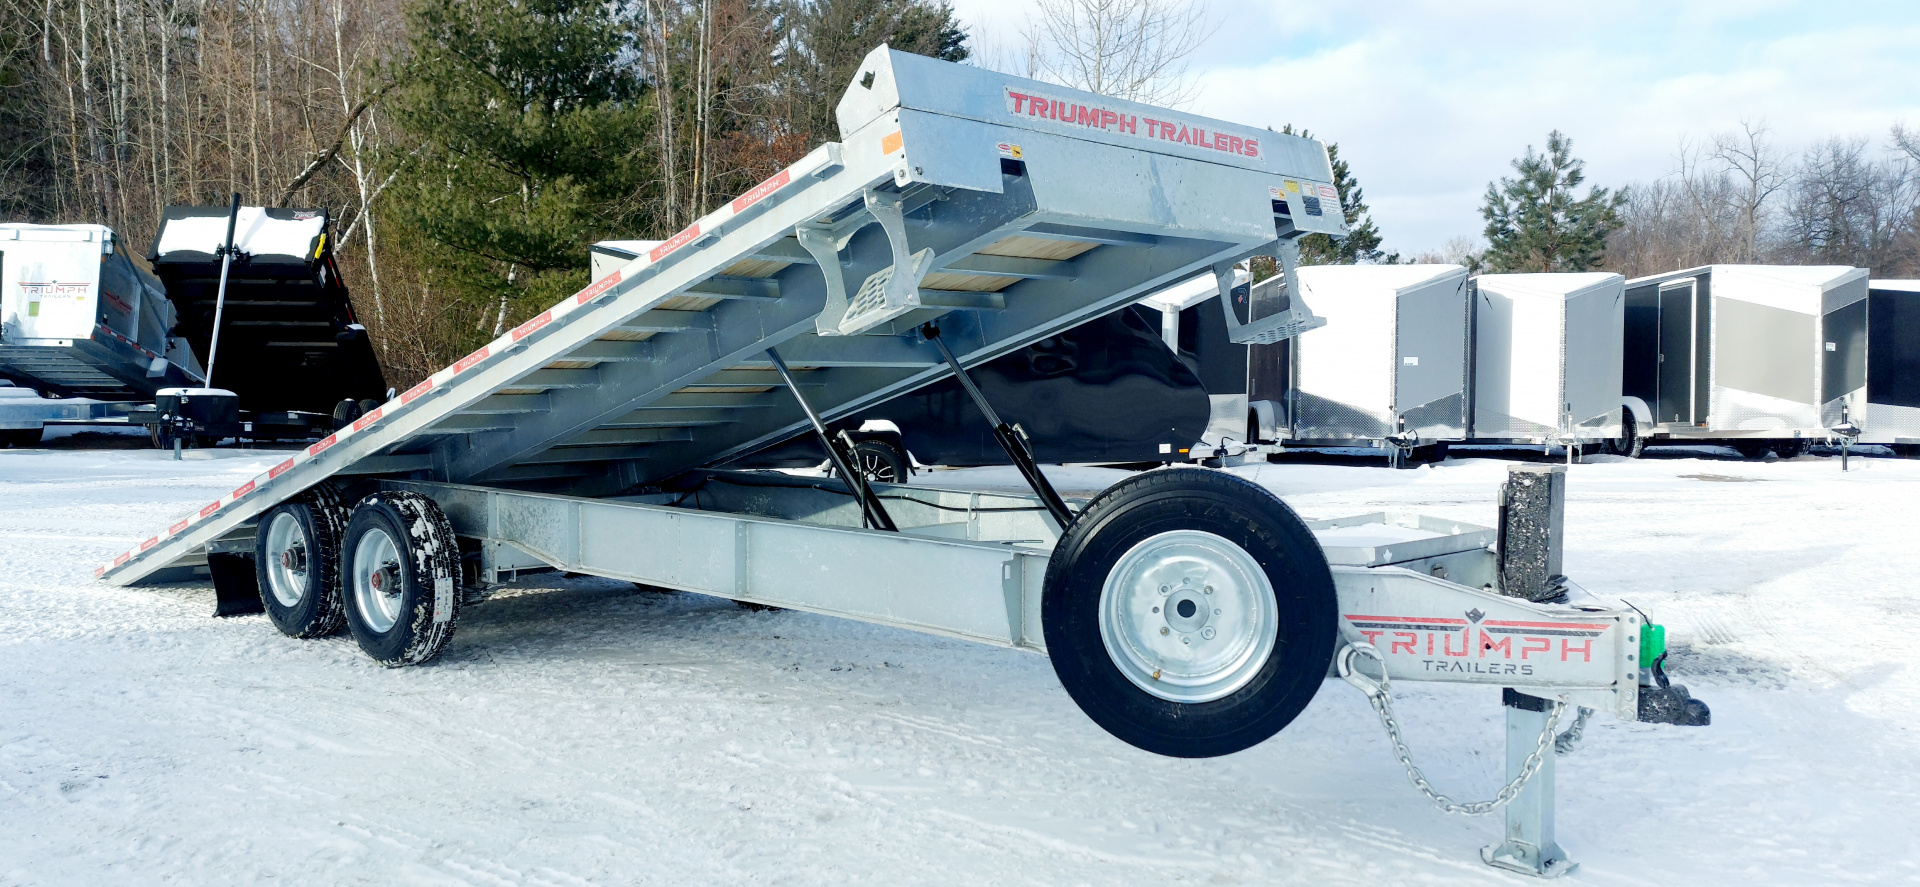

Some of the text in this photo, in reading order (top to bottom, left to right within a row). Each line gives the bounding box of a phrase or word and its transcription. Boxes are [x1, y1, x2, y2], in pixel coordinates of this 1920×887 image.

[1008, 91, 1260, 158] TRIUMPH TRAILERS
[742, 179, 780, 205] TRIUMPH
[659, 232, 691, 255] TRIUMPH
[22, 286, 87, 294] TRIUMPH
[585, 278, 613, 298] TRIUMPH
[519, 317, 546, 336] TRIUMPH
[459, 352, 483, 369] TRIUMPH
[1360, 627, 1594, 663] TRIUMPH
[1423, 659, 1534, 676] TRAILERS
